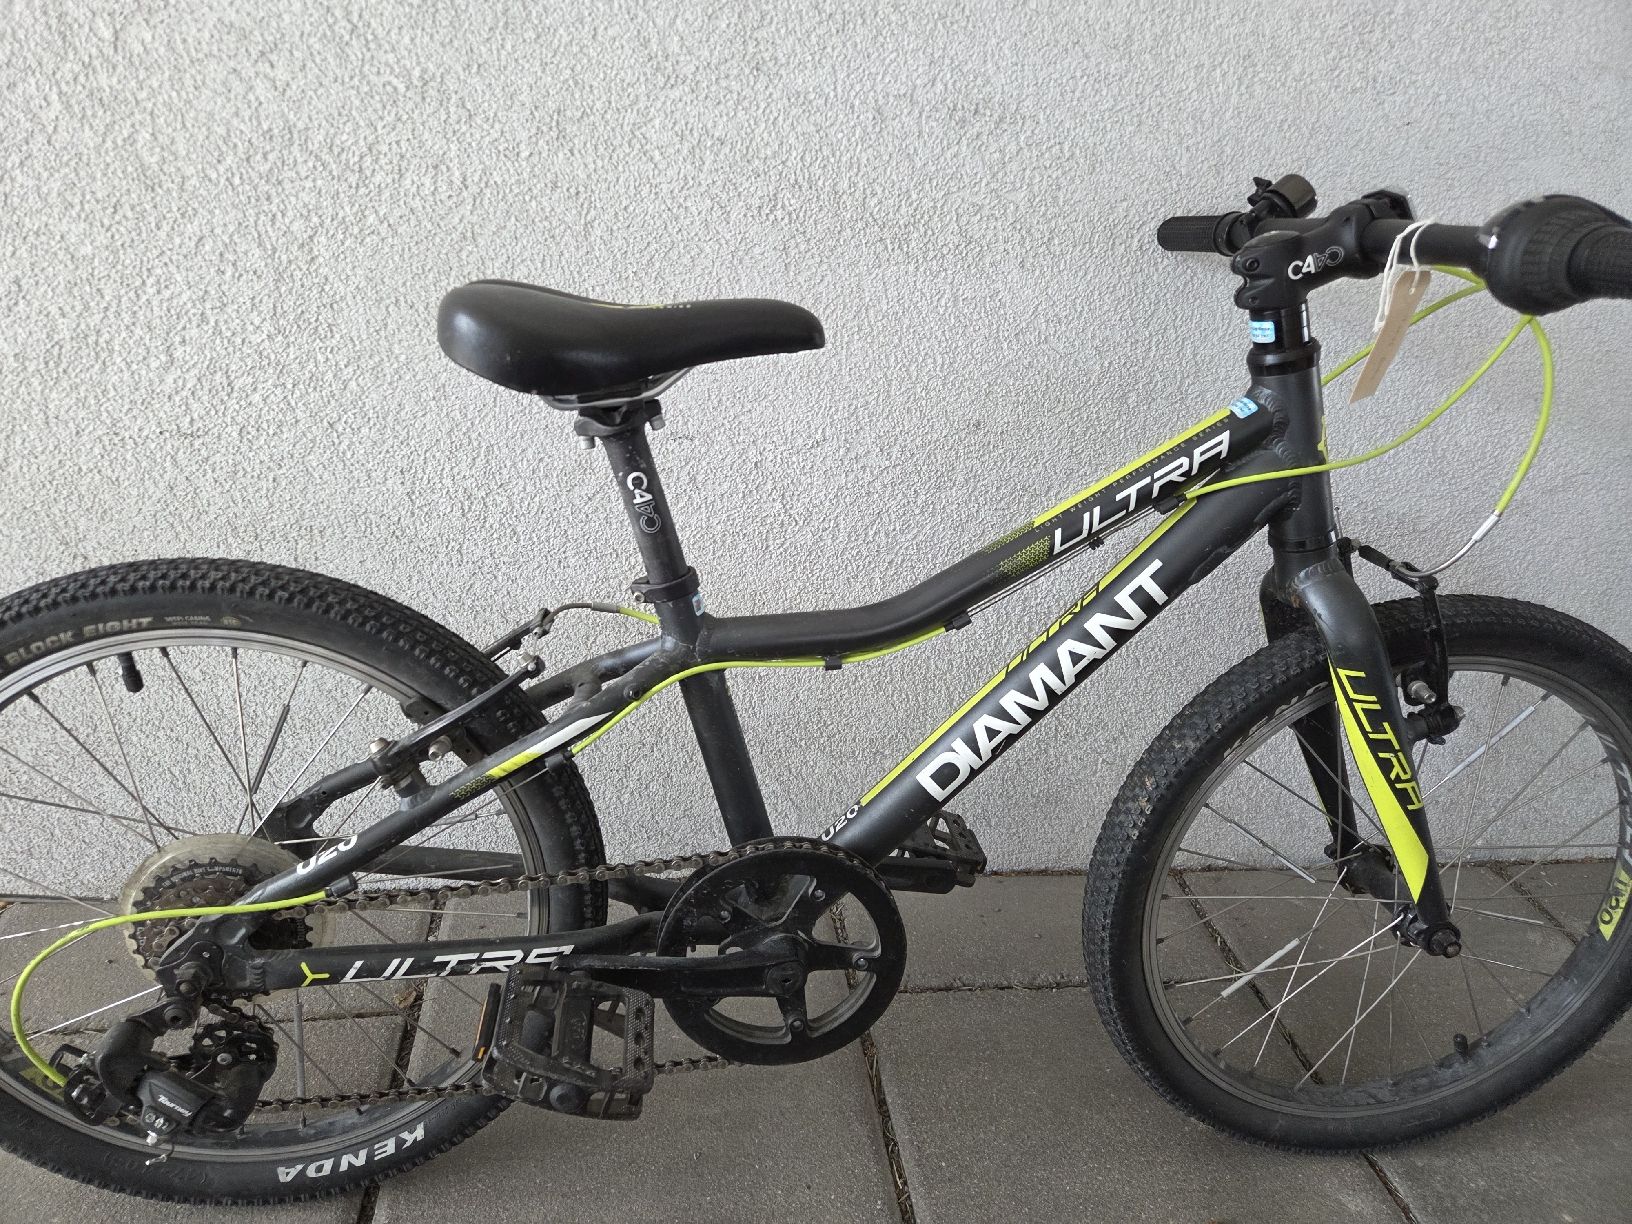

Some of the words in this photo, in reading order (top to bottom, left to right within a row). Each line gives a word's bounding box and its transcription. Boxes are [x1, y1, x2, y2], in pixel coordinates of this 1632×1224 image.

[1053, 430, 1230, 555] ULTRA
[4, 629, 75, 666] BLOCK
[83, 617, 154, 638] EIGHT
[915, 558, 1169, 802] DIAMANT
[1336, 667, 1424, 811] ULTRA
[821, 804, 859, 841] U20
[276, 1121, 426, 1183] KENDA
